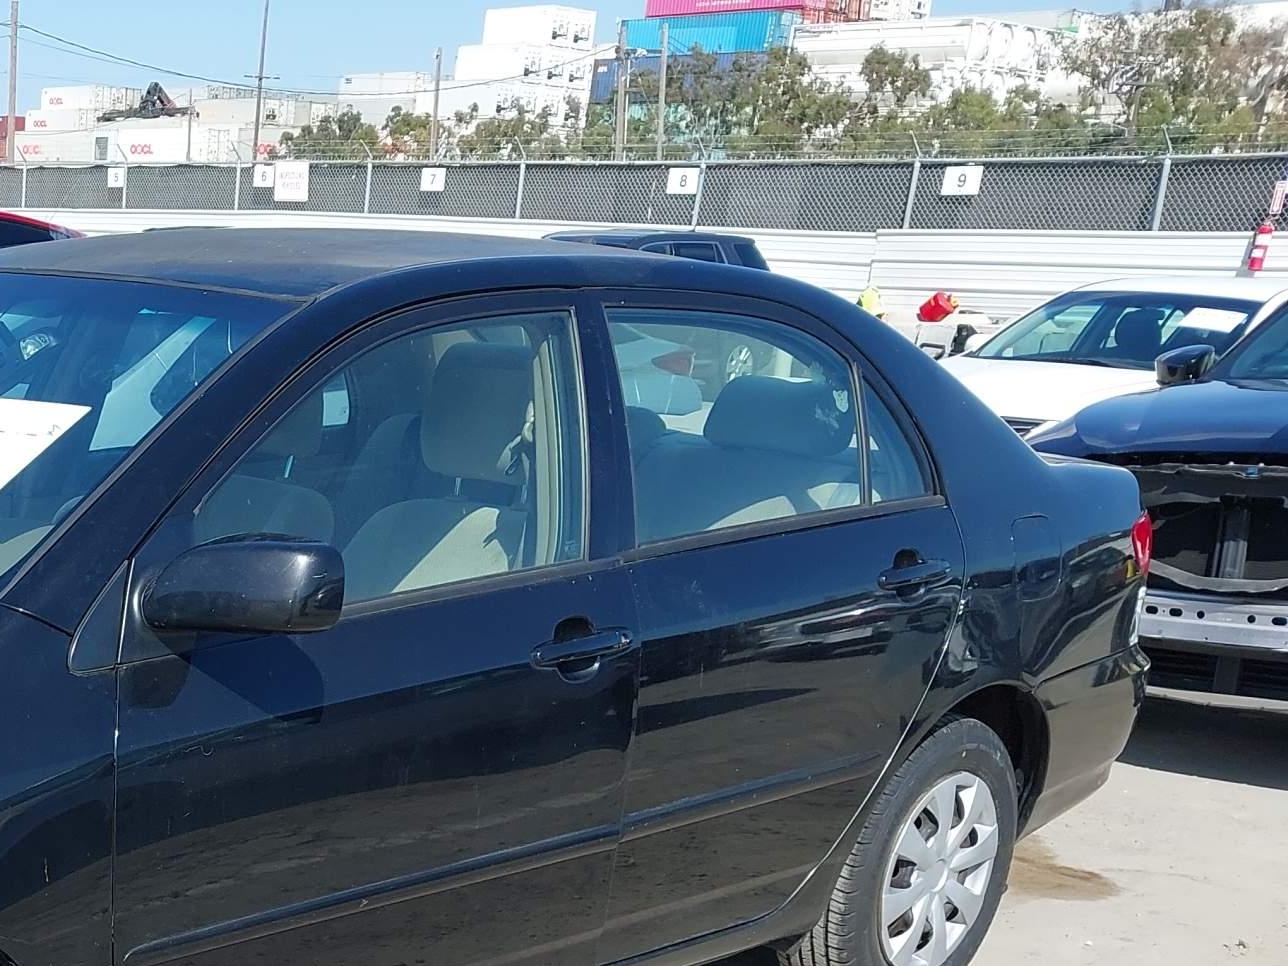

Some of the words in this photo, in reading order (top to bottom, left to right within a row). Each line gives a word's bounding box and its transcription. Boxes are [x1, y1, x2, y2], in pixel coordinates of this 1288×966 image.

[130, 144, 153, 154] OOCL
[113, 172, 119, 182] 5
[261, 171, 268, 182] 6
[429, 173, 437, 185] 7
[679, 174, 688, 187] 8
[957, 173, 967, 188] 9
